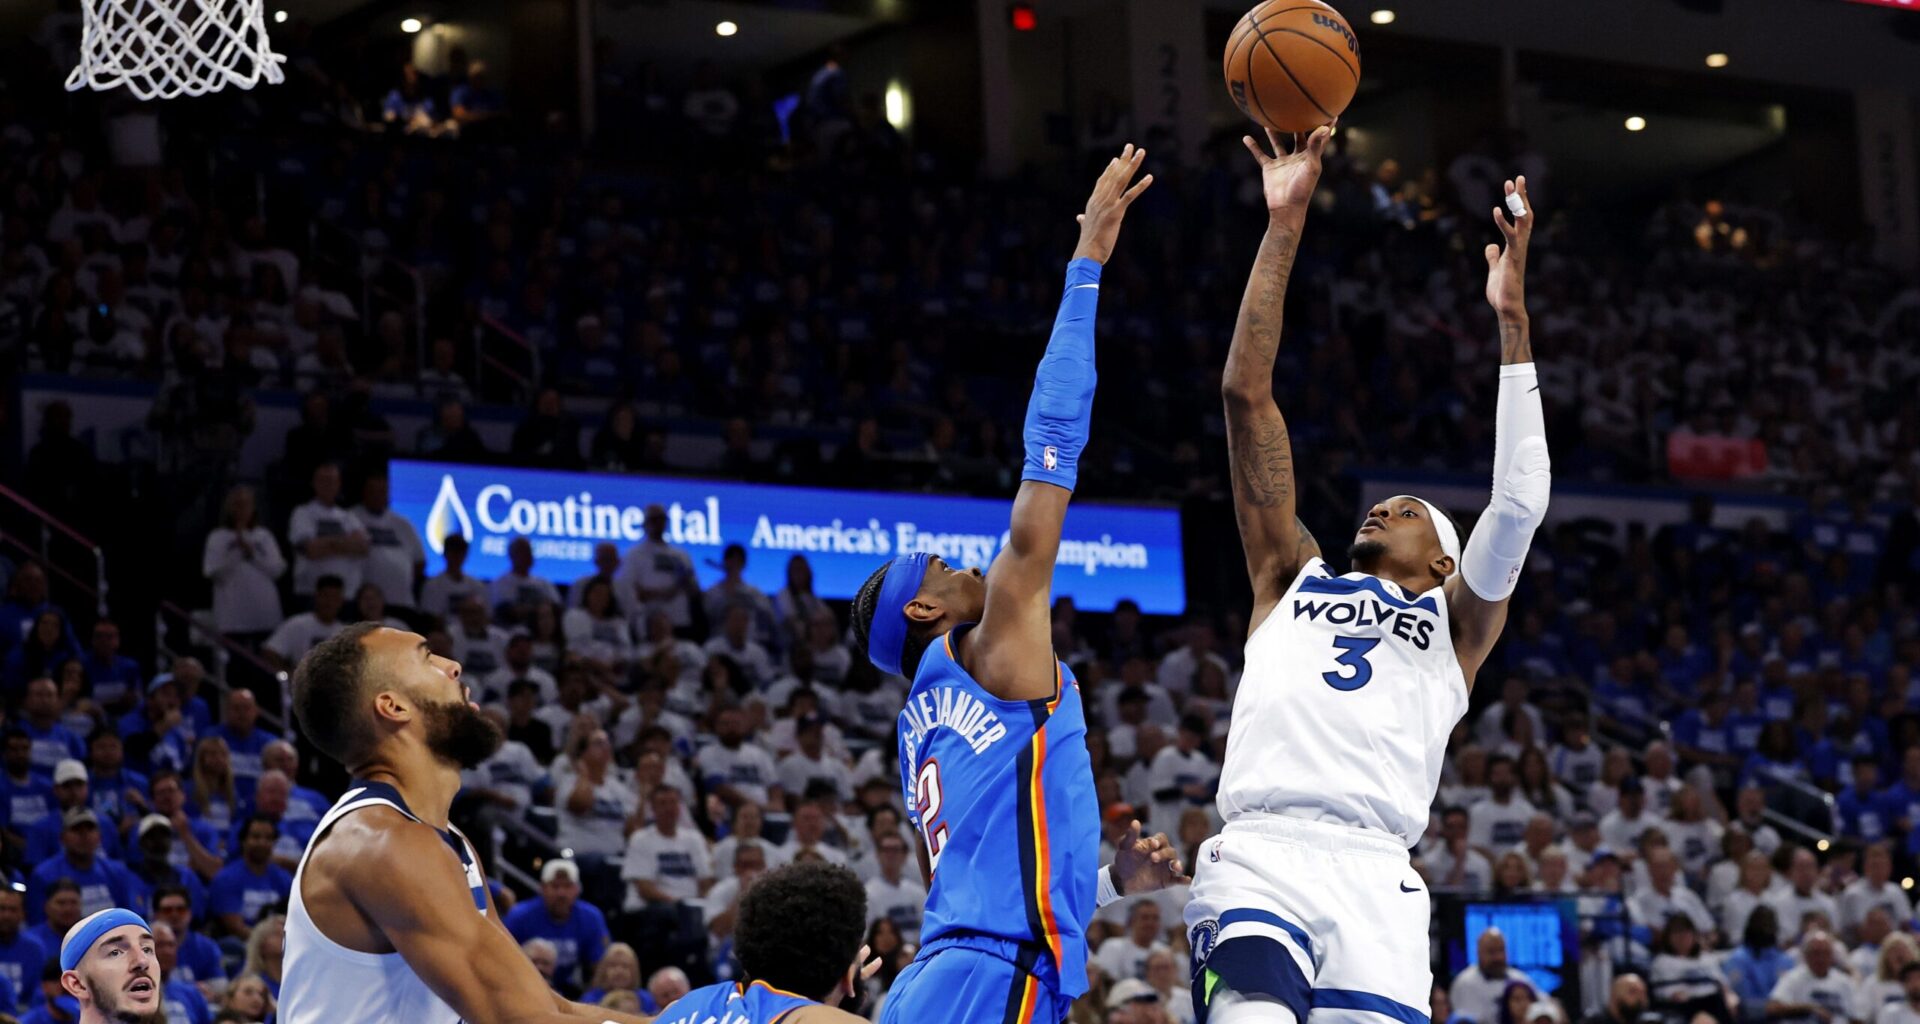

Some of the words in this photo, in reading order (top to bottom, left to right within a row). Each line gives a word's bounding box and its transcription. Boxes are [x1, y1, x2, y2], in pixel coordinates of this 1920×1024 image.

[476, 484, 722, 545] Continetal
[751, 514, 891, 554] America's
[896, 522, 997, 570] Energy
[1001, 530, 1149, 575] mpion
[1293, 599, 1435, 651] WOLVES
[1321, 634, 1382, 691] 3
[915, 757, 949, 882] 2
